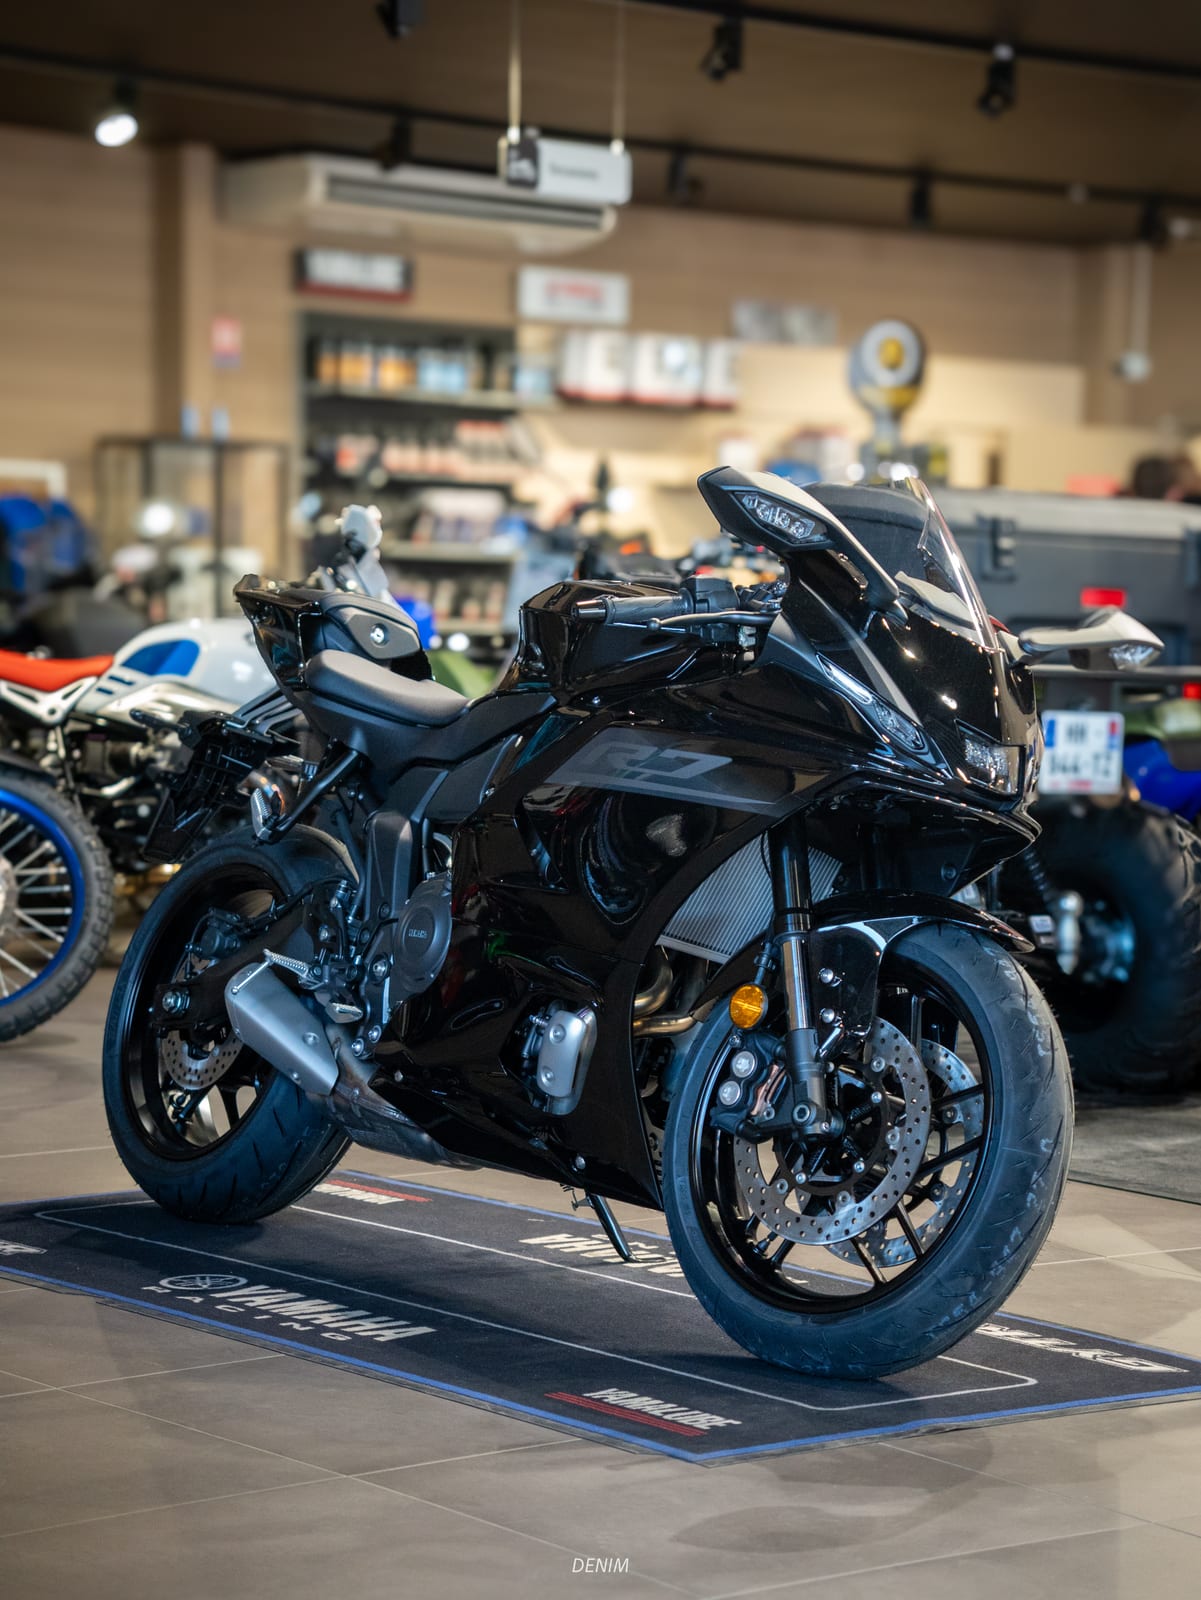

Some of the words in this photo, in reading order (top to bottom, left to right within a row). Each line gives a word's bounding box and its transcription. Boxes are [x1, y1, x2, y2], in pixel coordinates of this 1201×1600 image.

[141, 1285, 352, 1342] RACING
[210, 1284, 437, 1342] YAMAHA
[582, 1387, 742, 1430] YAMALUBE
